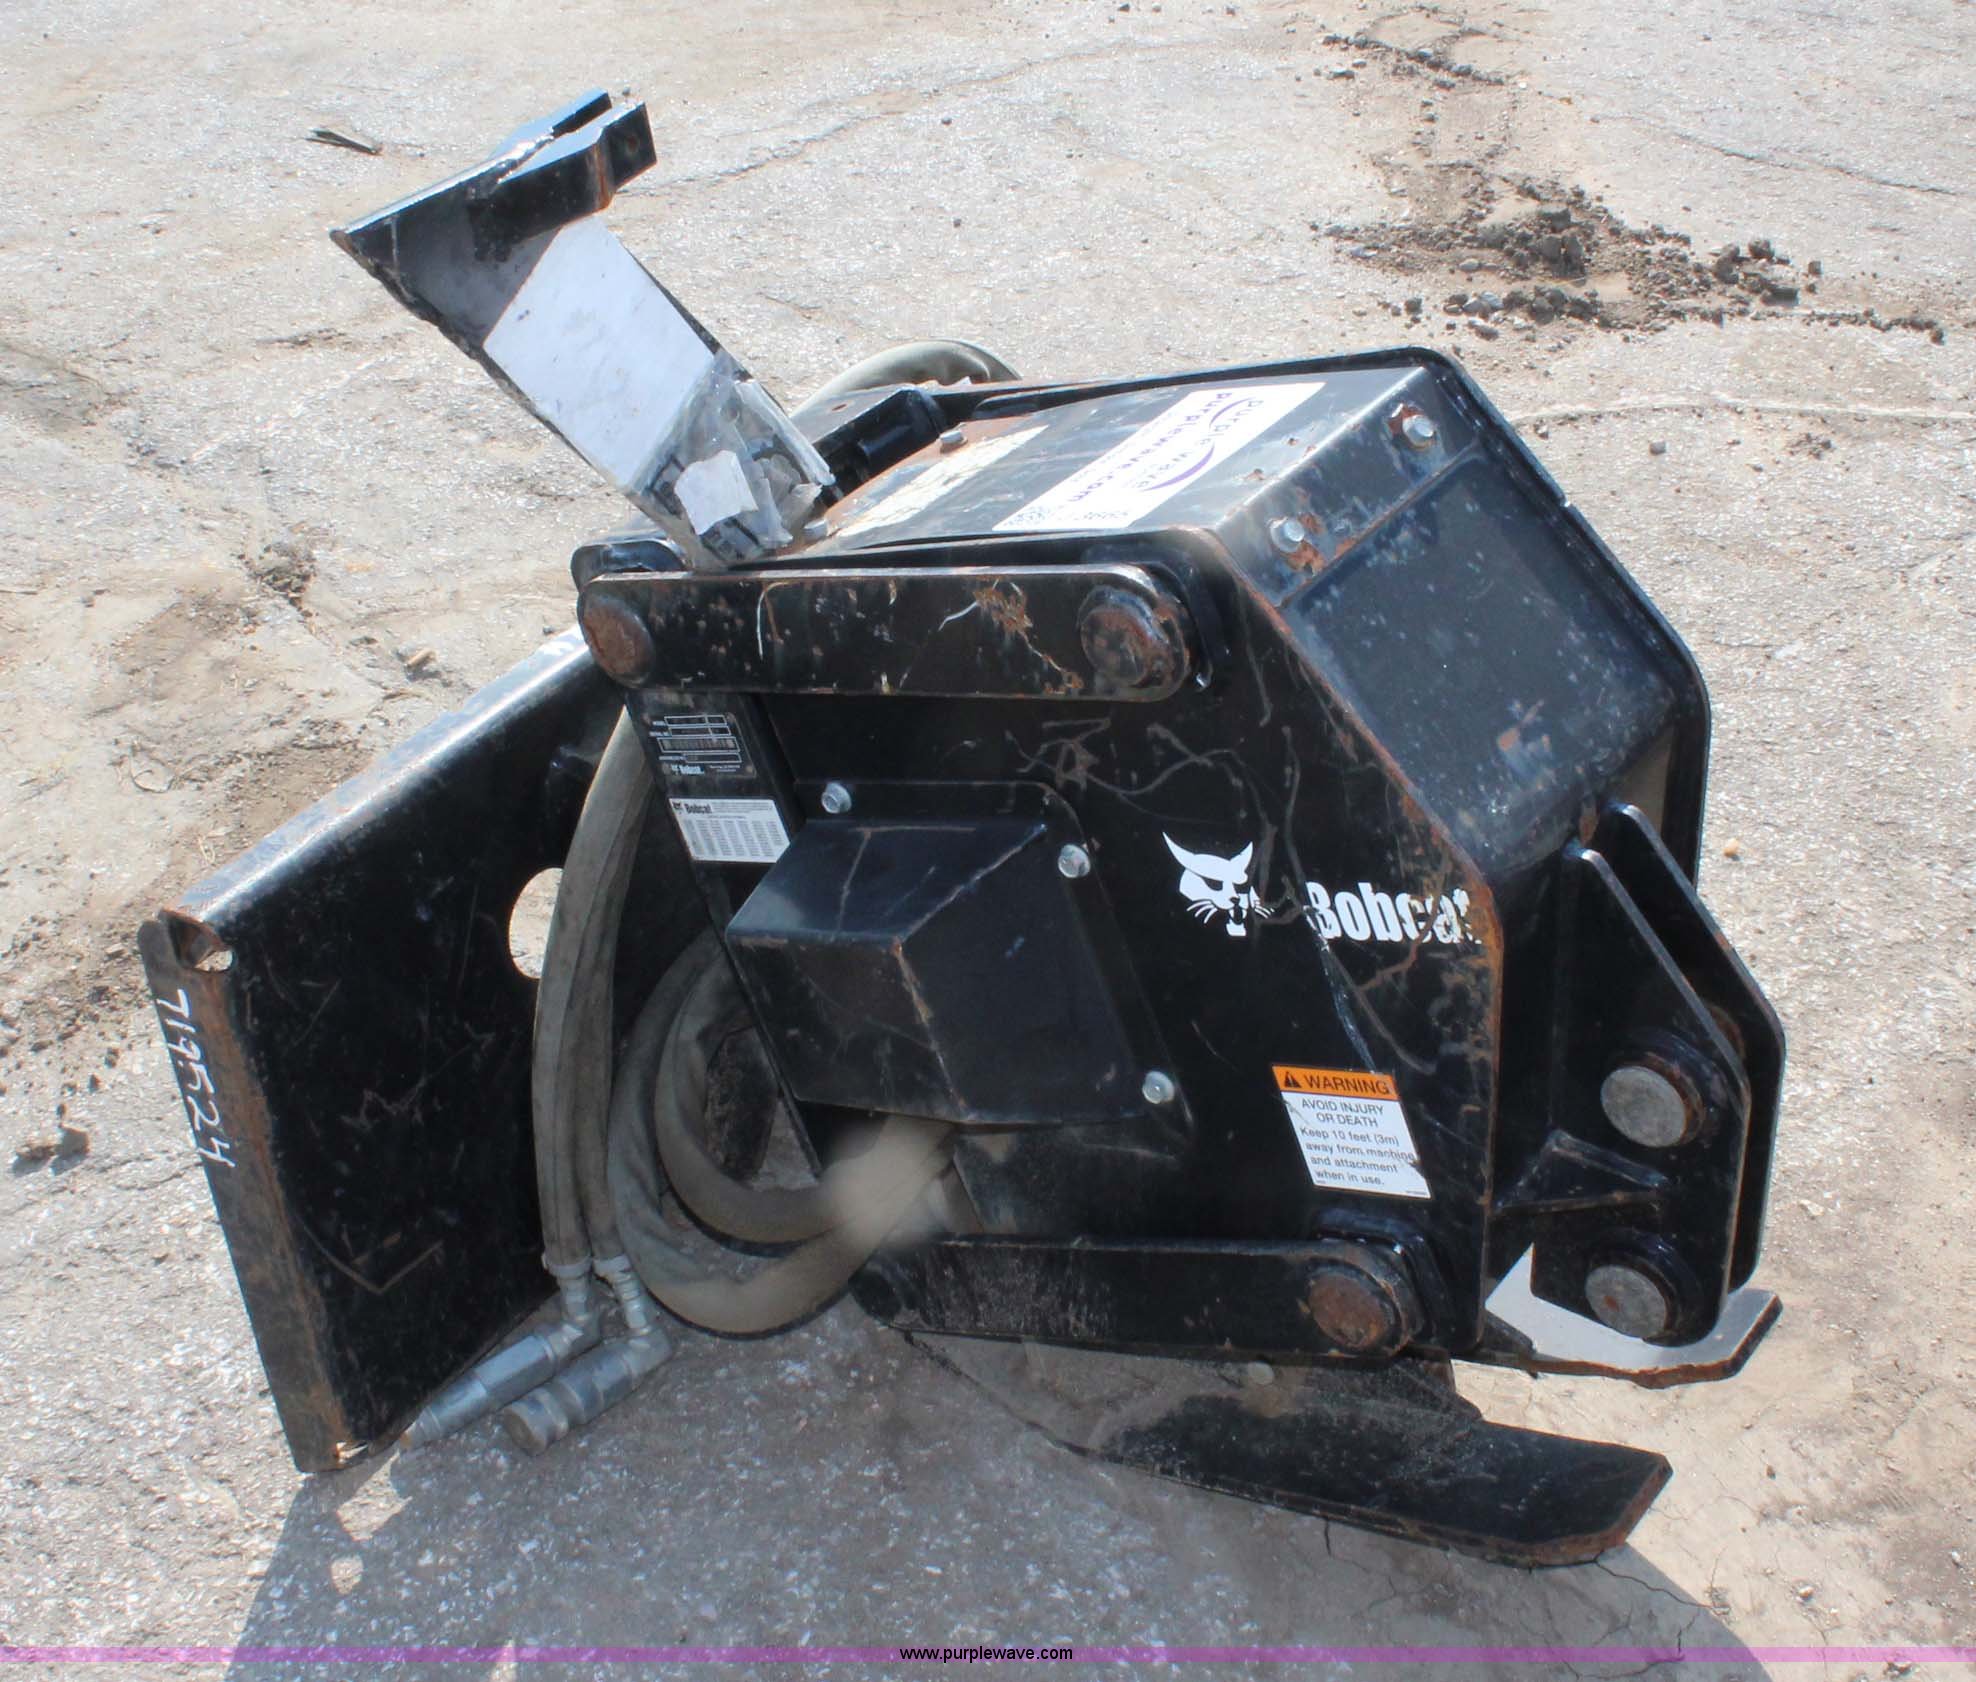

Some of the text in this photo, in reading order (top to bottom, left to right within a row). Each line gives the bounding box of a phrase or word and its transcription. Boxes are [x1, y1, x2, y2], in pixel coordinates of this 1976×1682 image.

[1304, 1074, 1390, 1095] WARNING
[1301, 1098, 1384, 1115] AVOID INJURY
[1316, 1113, 1378, 1128] OR DEATH
[1299, 1126, 1400, 1147] Keep 10 feet (3m)
[1305, 1142, 1416, 1161] away from machine
[1310, 1155, 1398, 1173] and attachment
[1315, 1169, 1385, 1186] when in use.
